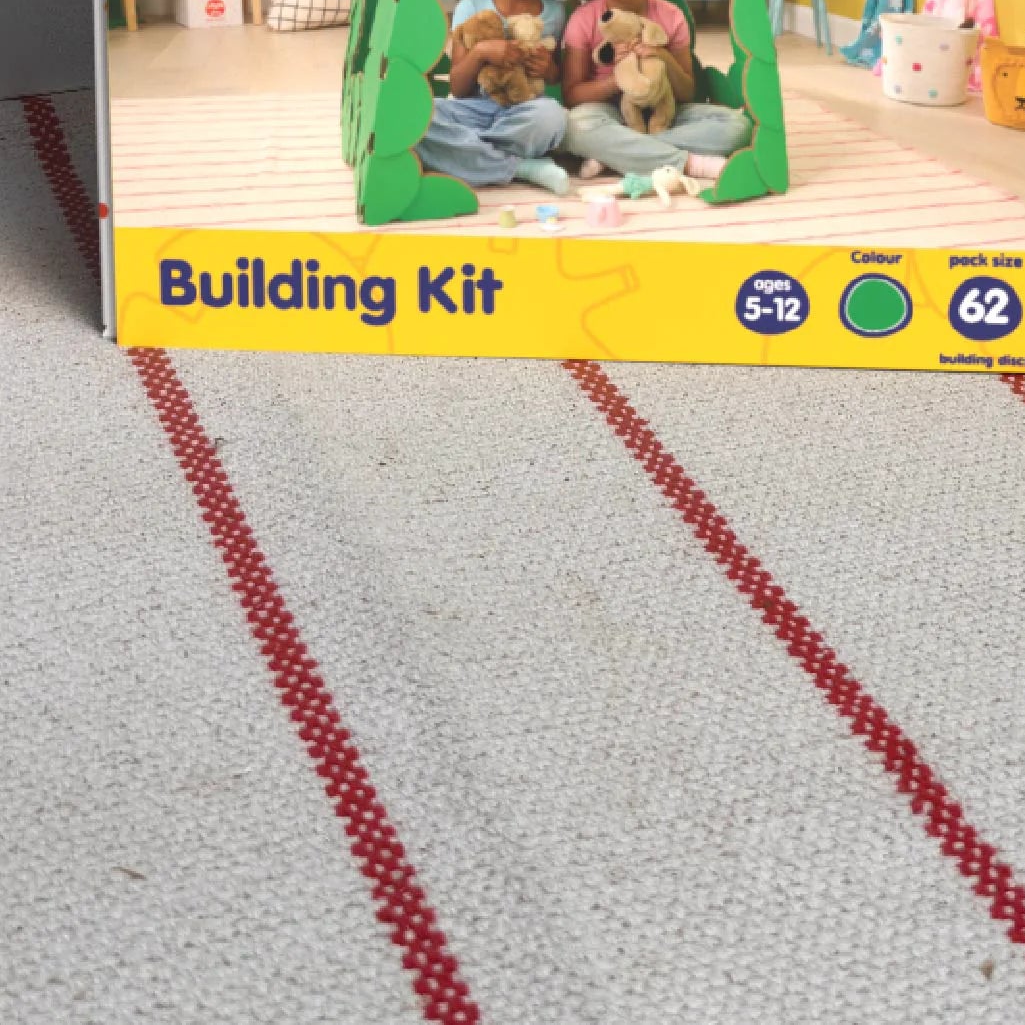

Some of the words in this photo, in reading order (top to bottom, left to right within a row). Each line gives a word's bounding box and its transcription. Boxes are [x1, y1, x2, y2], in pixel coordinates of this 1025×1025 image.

[850, 250, 903, 265] Colour
[949, 253, 988, 270] pack
[991, 254, 1023, 269] size
[159, 257, 397, 326] Building
[417, 263, 504, 315] Kit
[753, 278, 792, 294] ages
[743, 296, 802, 322] 5-12
[958, 287, 1010, 324] 62
[939, 353, 993, 368] building
